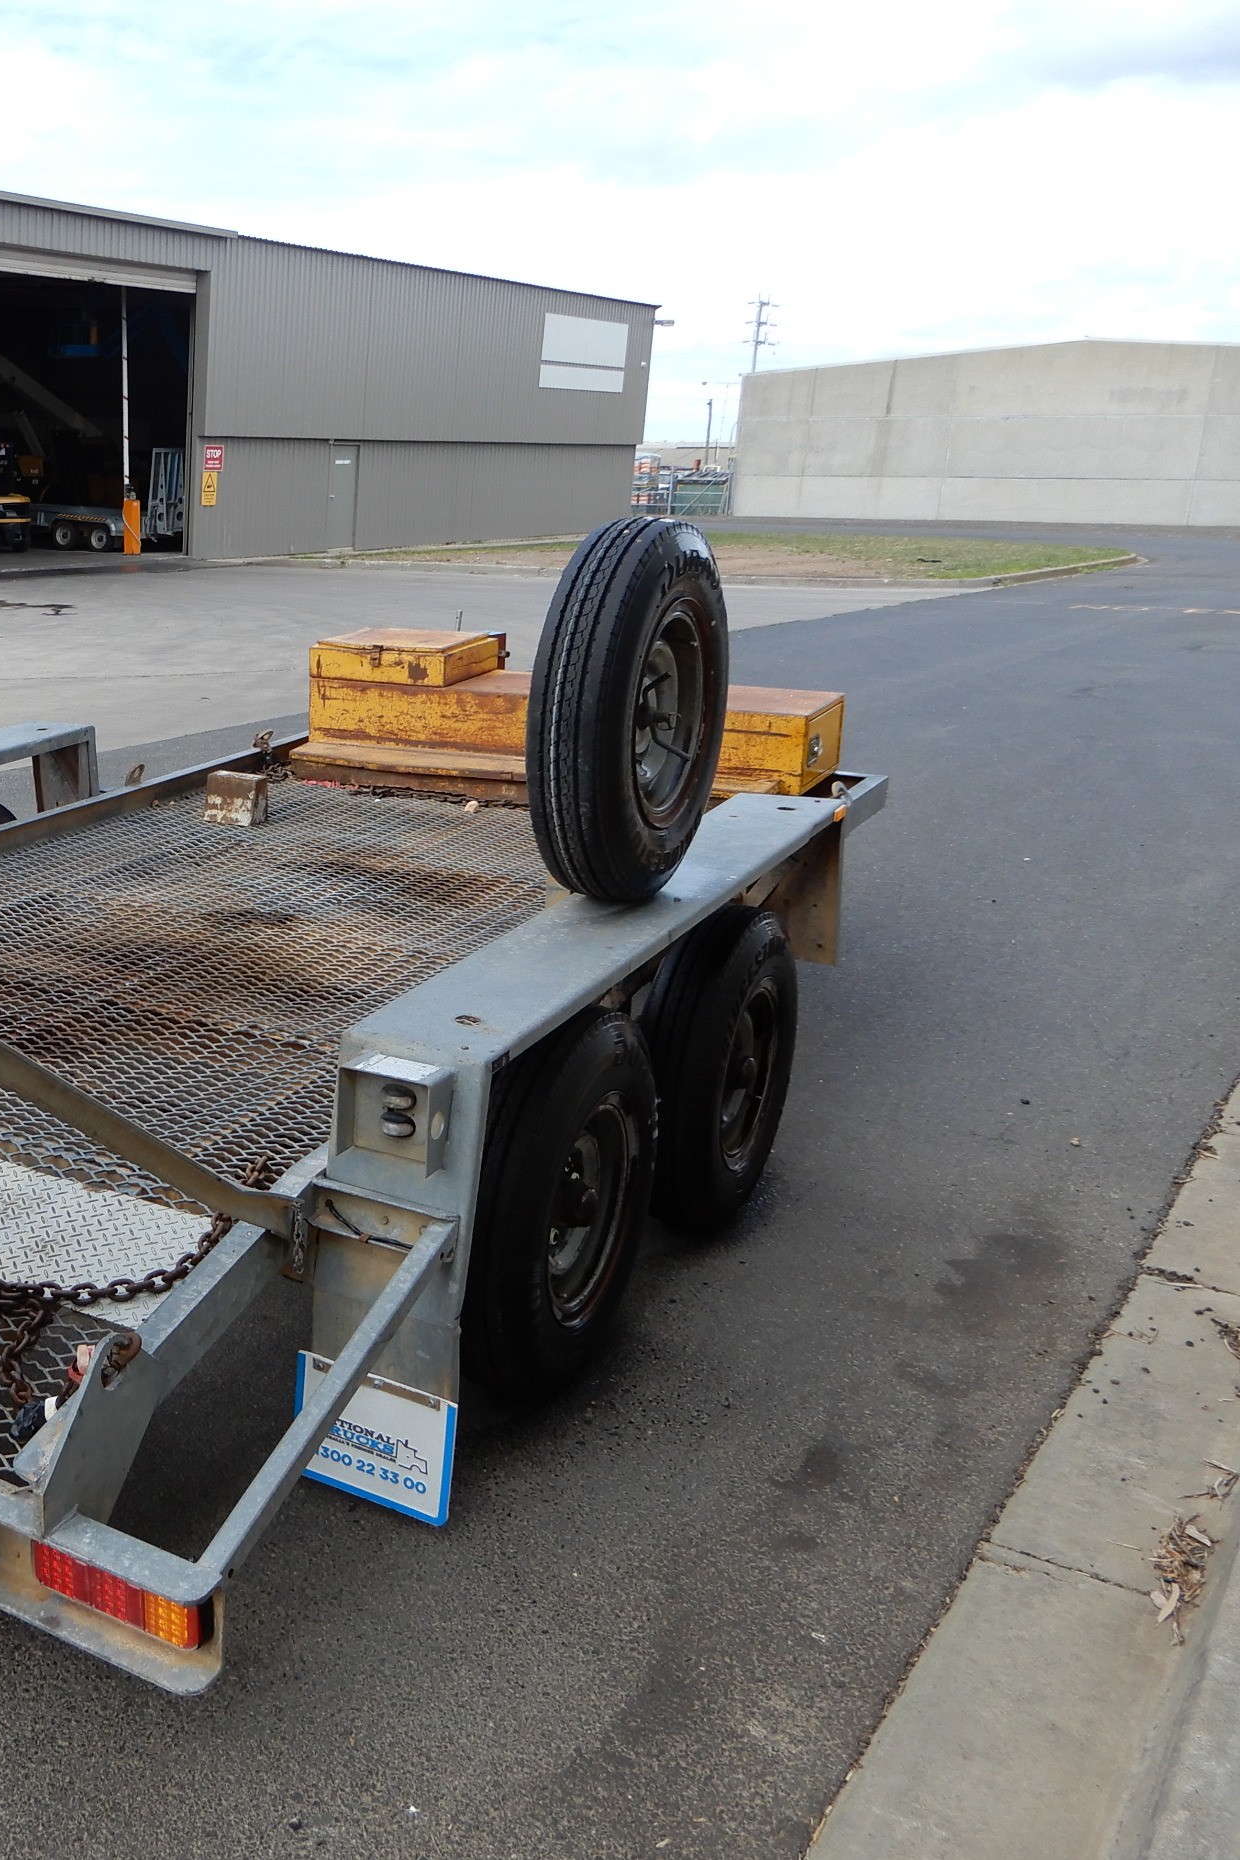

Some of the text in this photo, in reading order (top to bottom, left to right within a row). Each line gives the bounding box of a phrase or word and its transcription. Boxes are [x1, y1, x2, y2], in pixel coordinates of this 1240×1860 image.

[206, 449, 221, 458] STOP
[329, 1426, 395, 1455] RUCKS
[334, 1418, 395, 1446] TIONAL
[356, 1459, 376, 1476] 22
[379, 1467, 400, 1485] 33
[403, 1476, 427, 1495] 00
